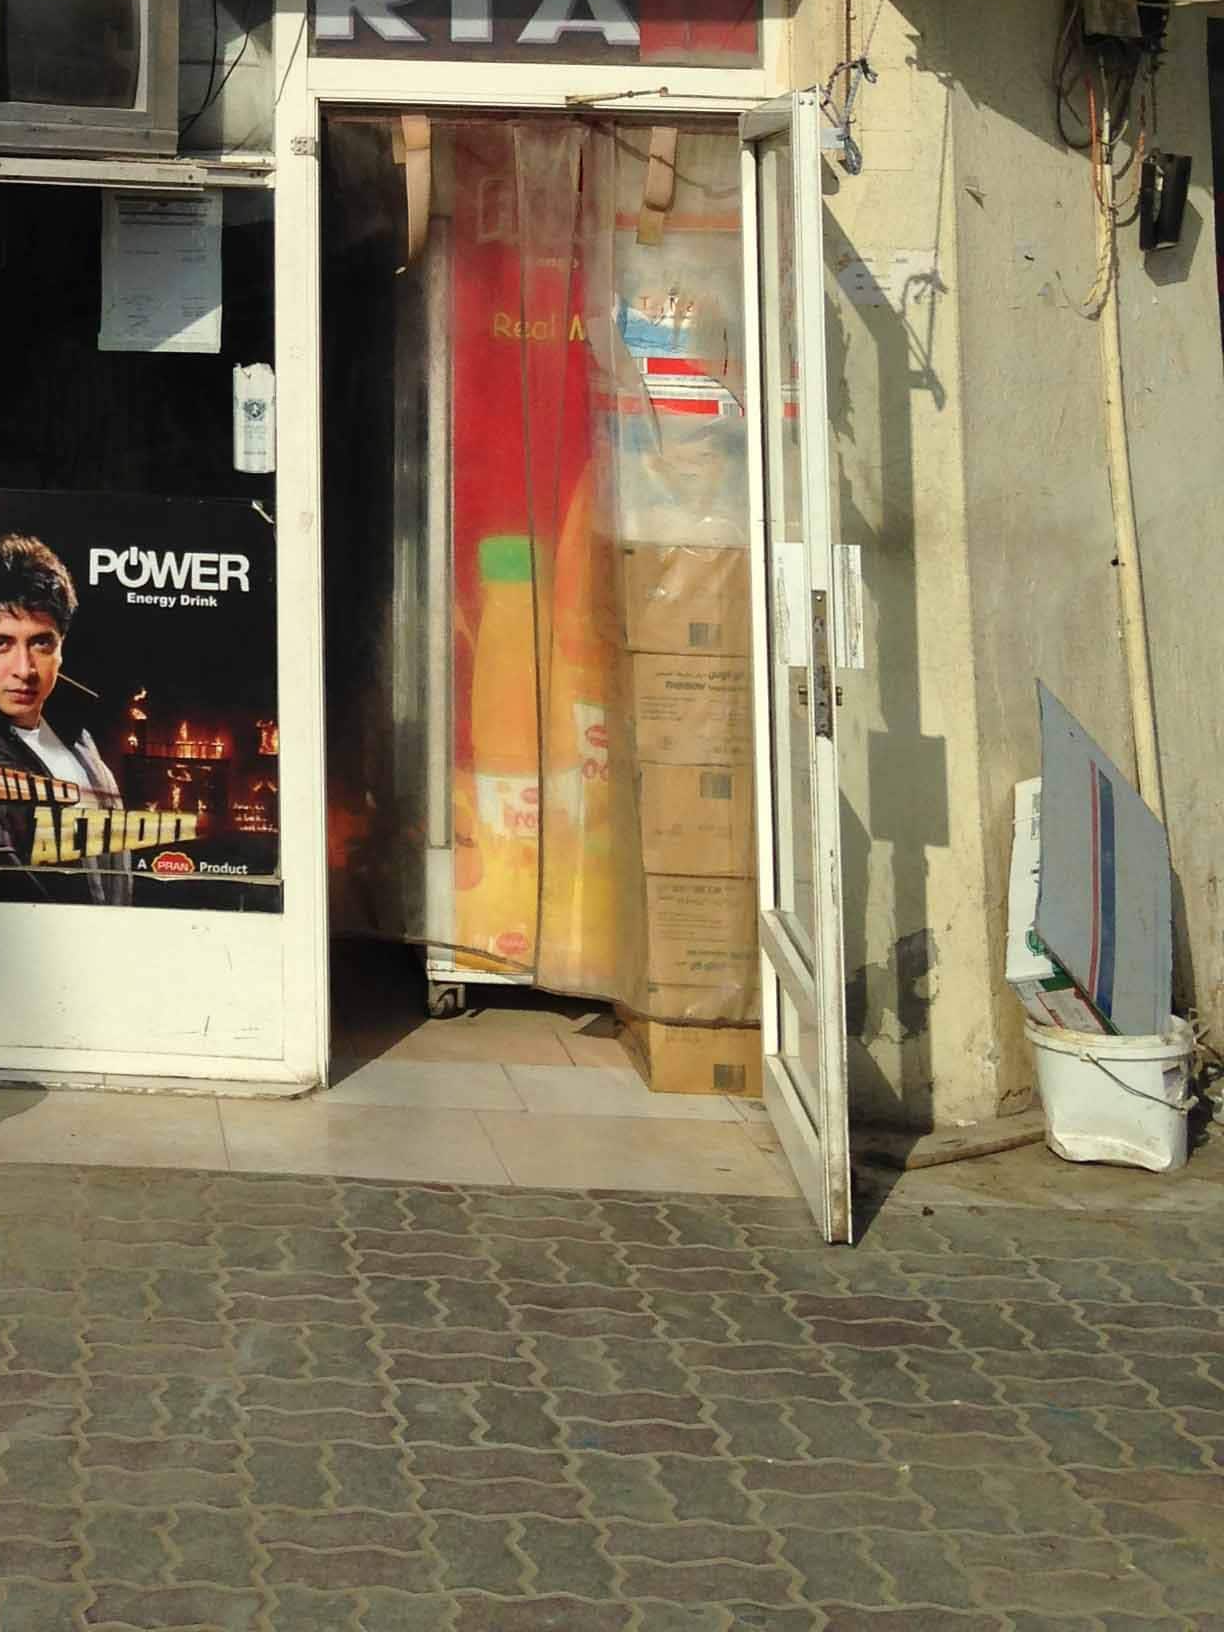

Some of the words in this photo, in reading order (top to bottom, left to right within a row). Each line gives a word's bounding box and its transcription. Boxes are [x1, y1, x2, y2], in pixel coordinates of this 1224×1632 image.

[88, 546, 251, 593] POWER
[127, 591, 177, 609] Energy
[180, 594, 218, 608] Drink
[137, 859, 148, 871] A
[157, 860, 190, 872] PRAN
[199, 861, 249, 876] Product
